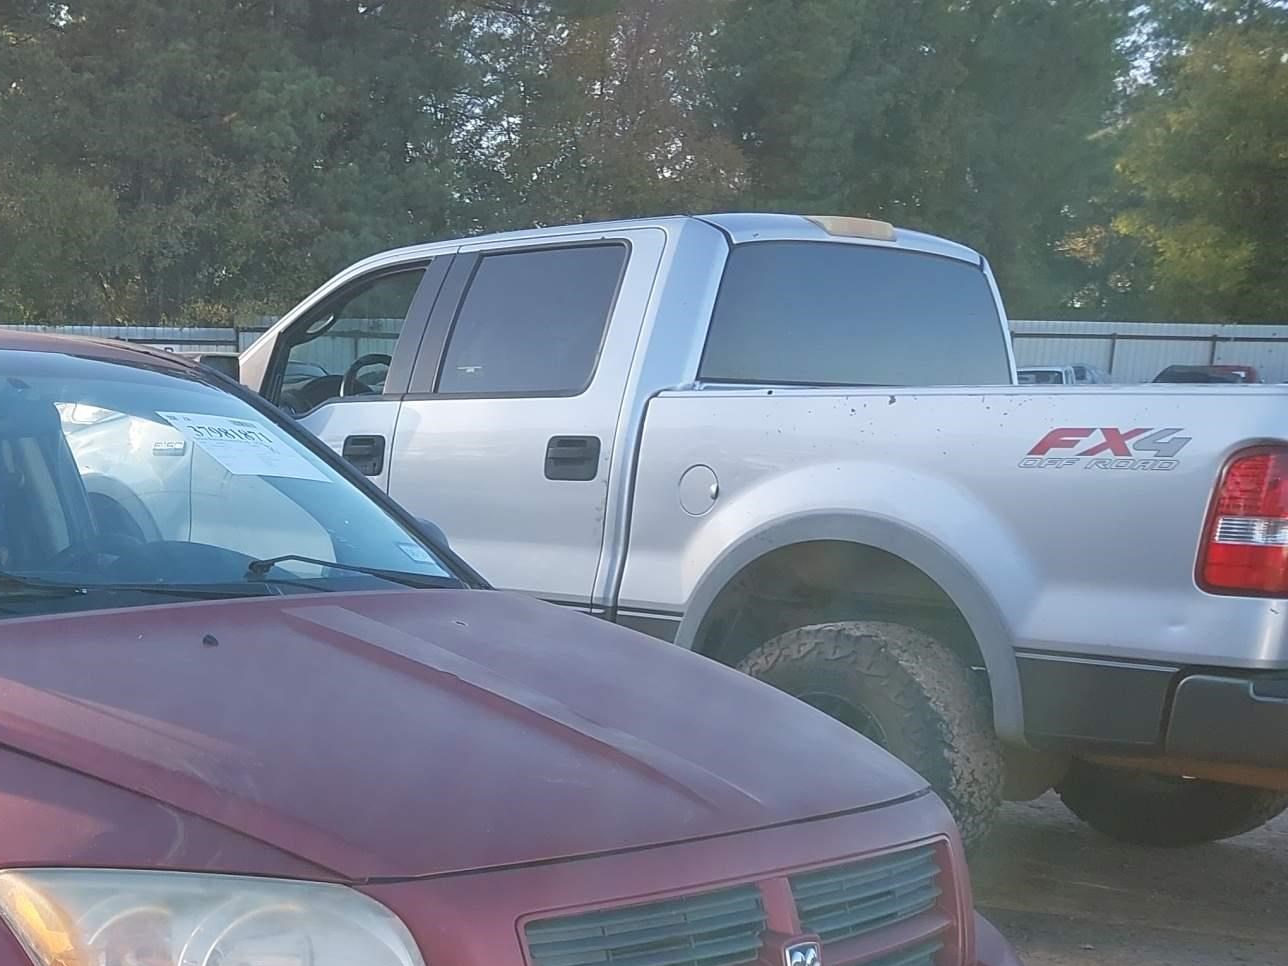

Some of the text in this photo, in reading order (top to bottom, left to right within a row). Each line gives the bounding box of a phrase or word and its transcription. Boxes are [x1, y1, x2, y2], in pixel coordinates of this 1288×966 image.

[185, 424, 273, 443] 37981871
[1026, 427, 1193, 458] FX4
[1017, 457, 1181, 471] OFF ROAD
